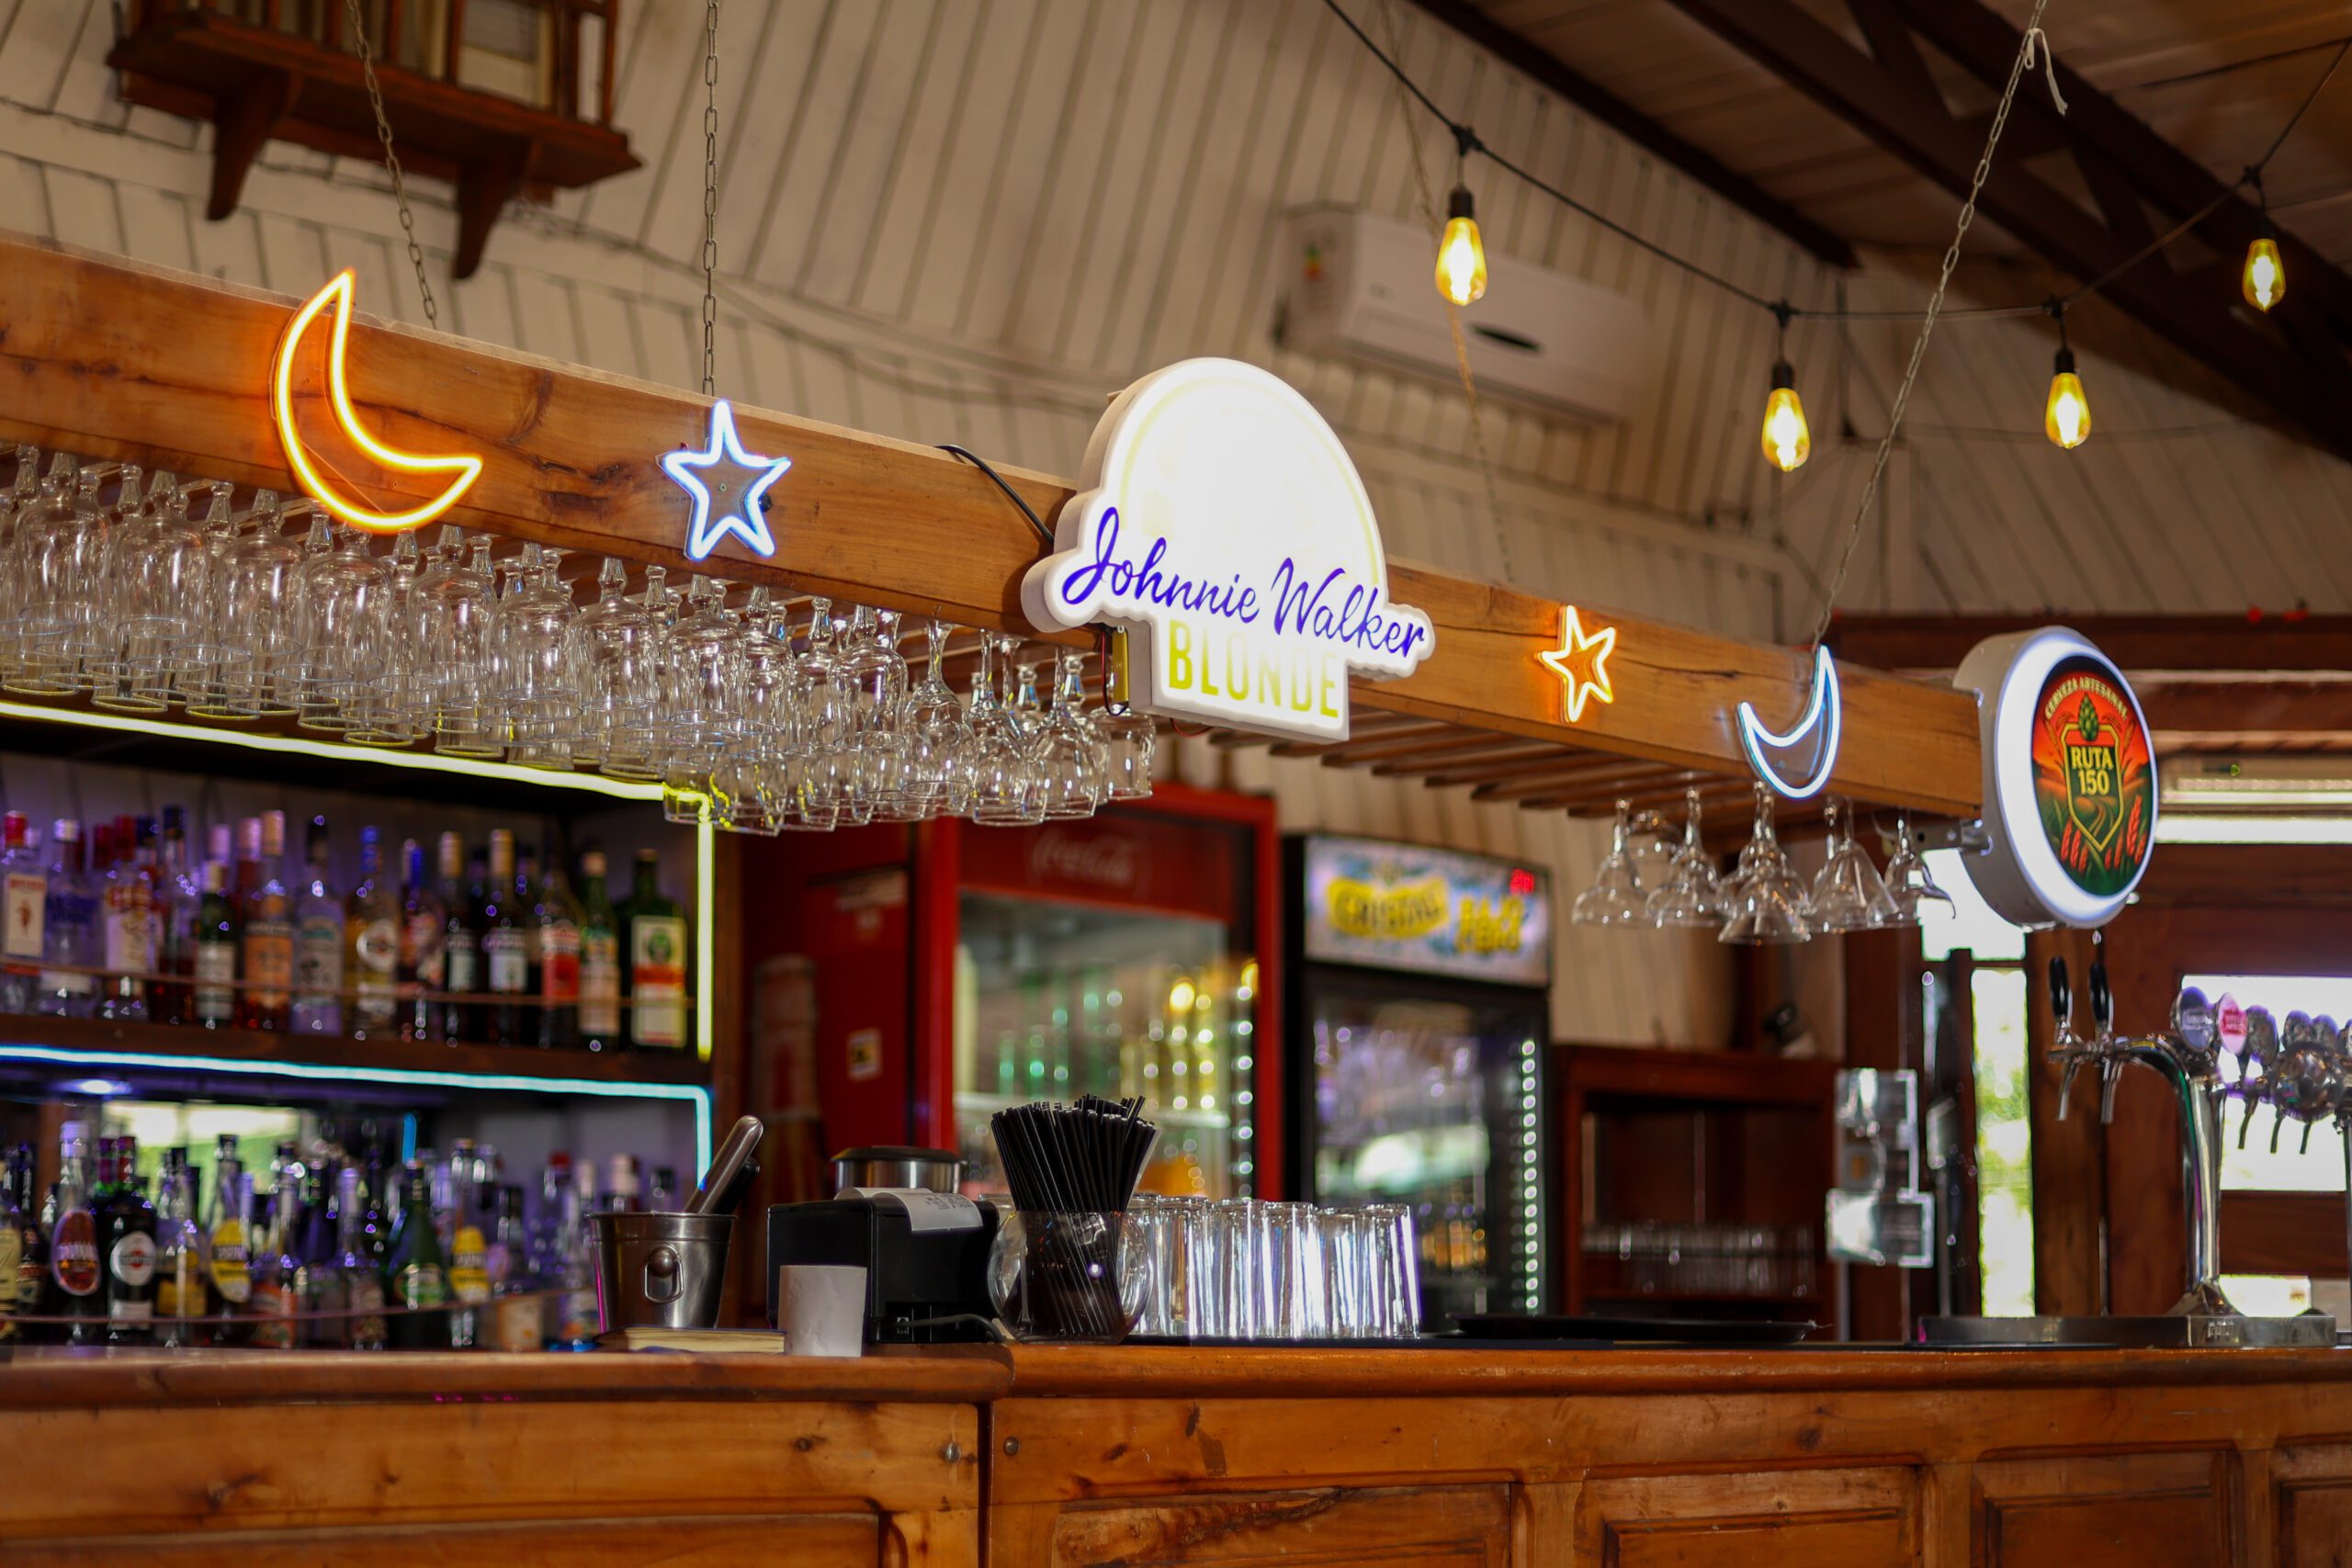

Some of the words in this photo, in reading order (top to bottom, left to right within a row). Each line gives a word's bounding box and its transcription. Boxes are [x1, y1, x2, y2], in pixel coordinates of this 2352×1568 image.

[1061, 506, 1261, 624] Johnnie
[1271, 557, 1425, 658] Walker
[1169, 618, 1340, 718] BLONDE
[2045, 677, 2078, 719] CERVEZA
[2071, 746, 2114, 771] RUTA
[2078, 769, 2110, 795] 150
